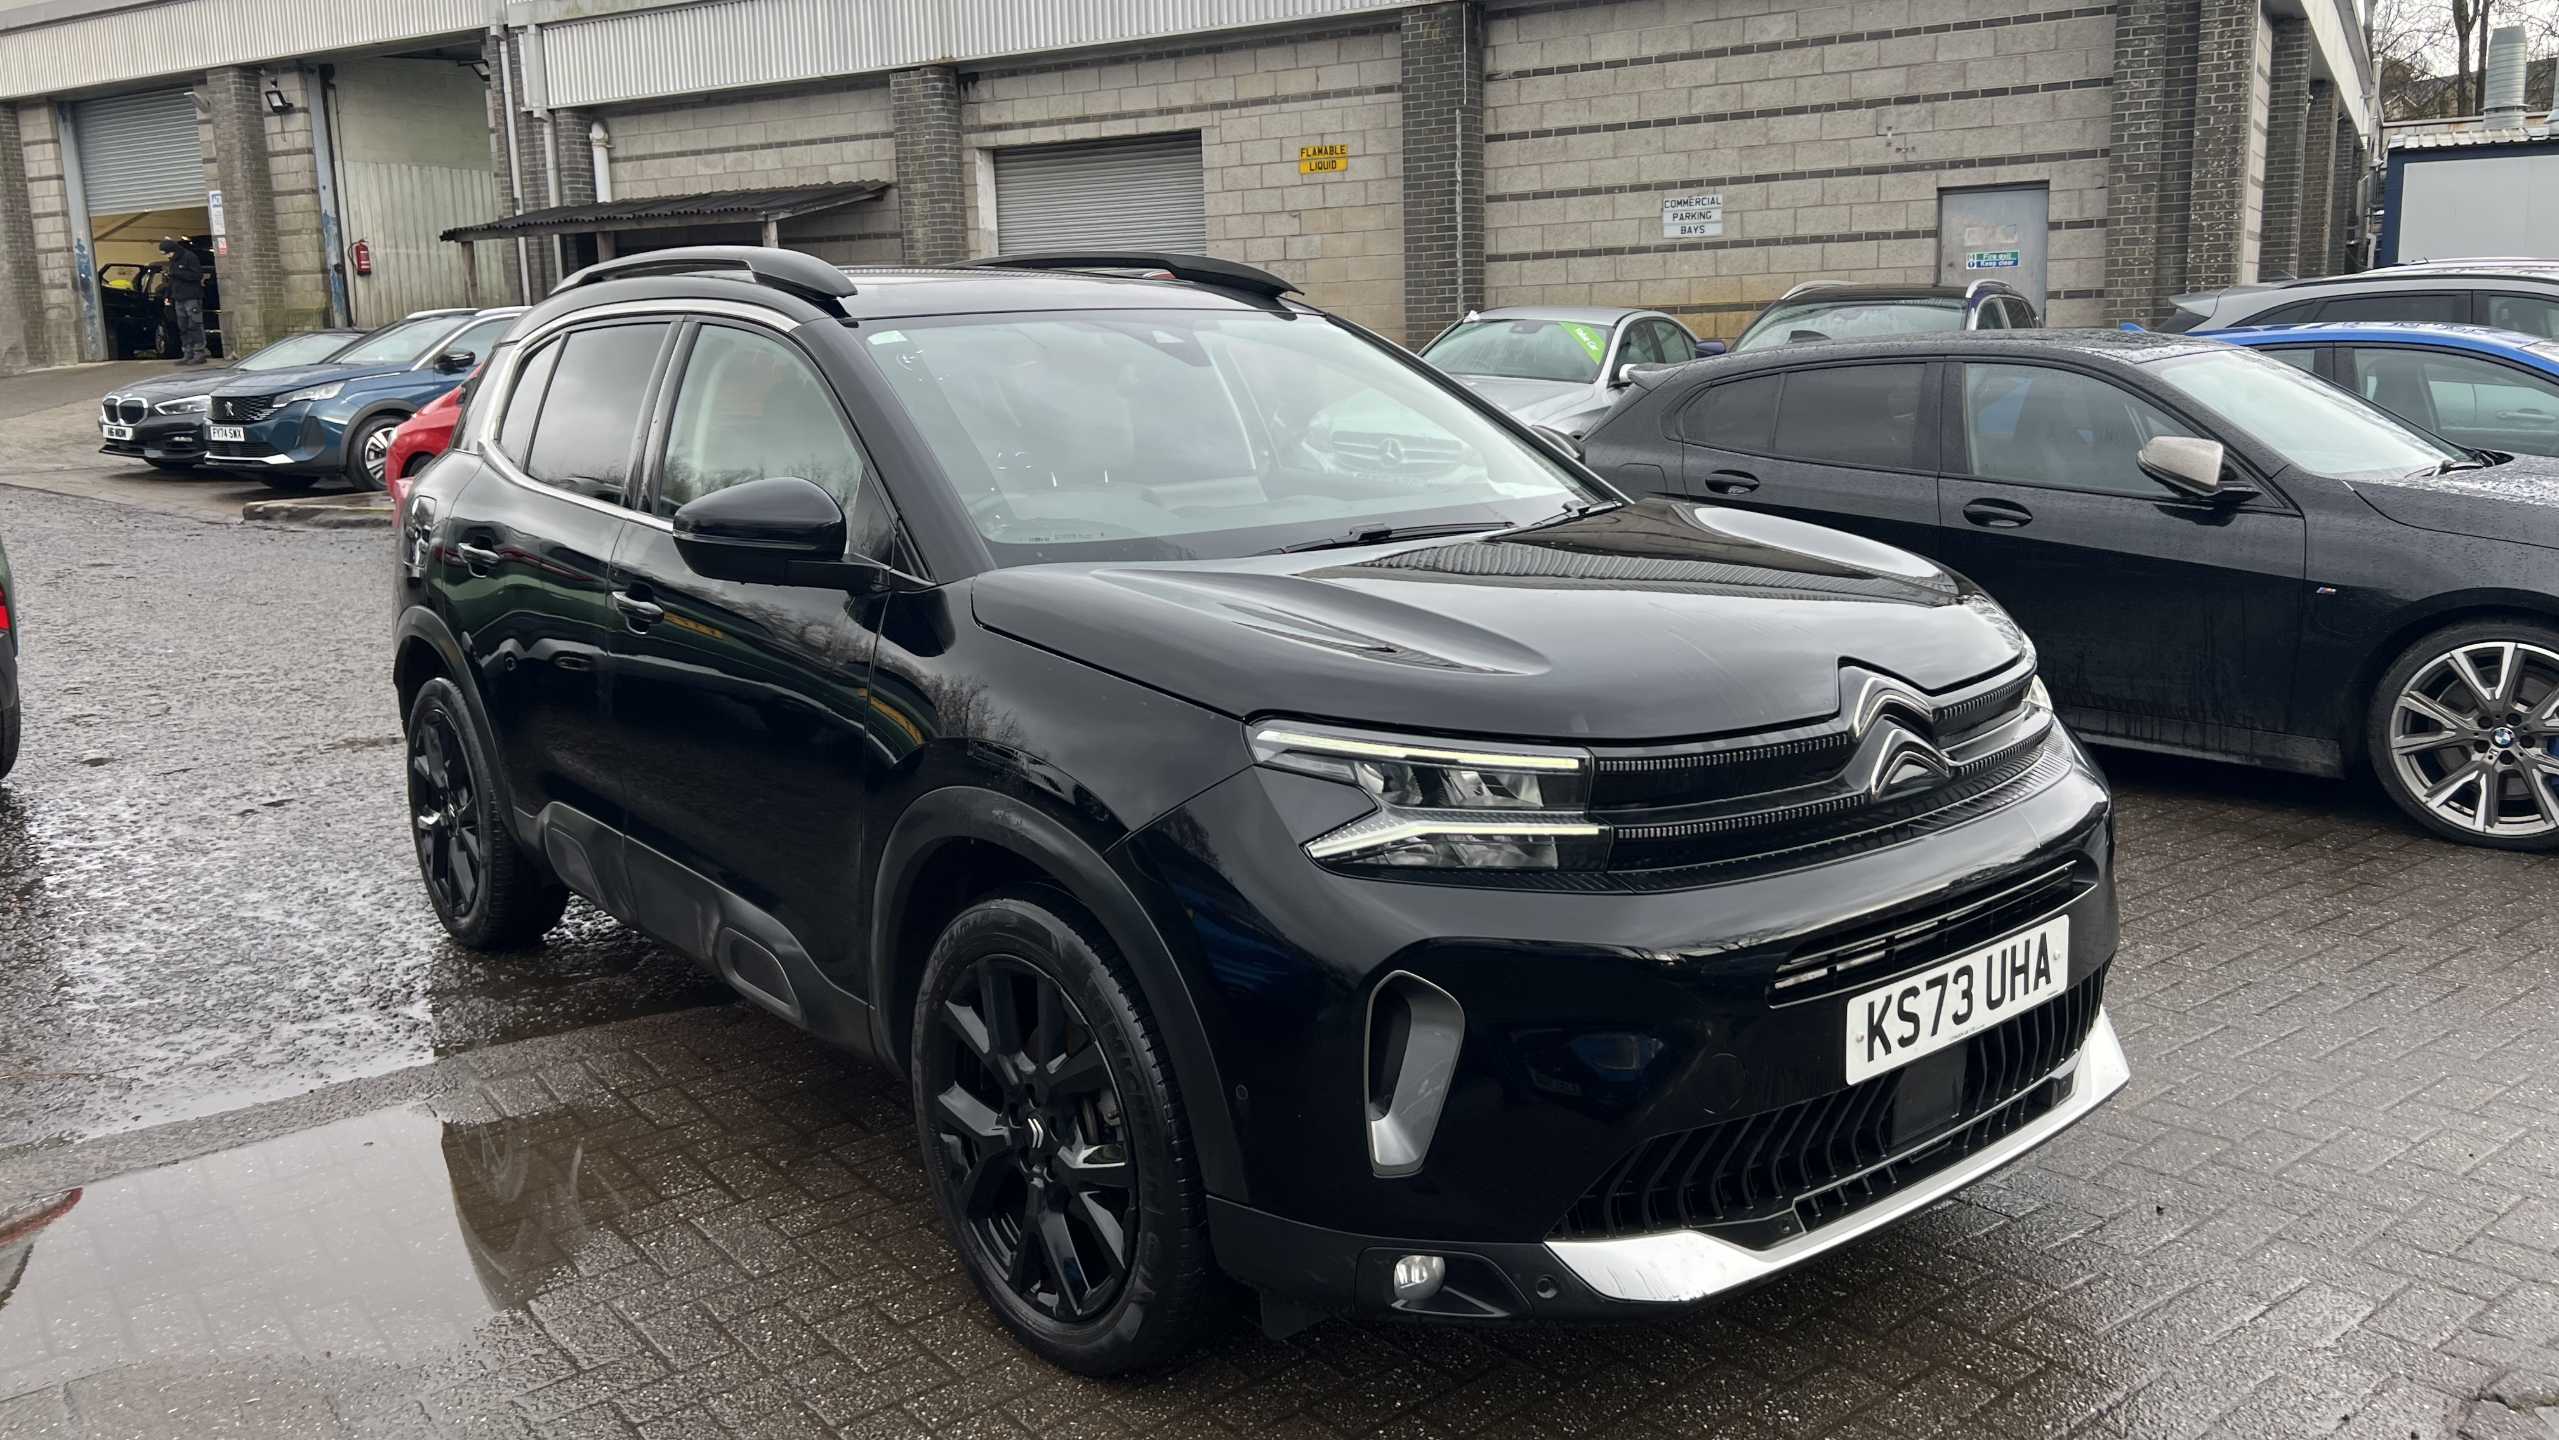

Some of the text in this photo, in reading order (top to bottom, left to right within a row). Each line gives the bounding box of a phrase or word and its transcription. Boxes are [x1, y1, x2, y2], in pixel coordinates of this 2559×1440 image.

[1300, 144, 1346, 158] FLAMABLE
[1309, 160, 1337, 171] LIQUID
[1664, 196, 1721, 209] COMMERCIAL
[1672, 211, 1712, 221] PARKING
[1680, 225, 1705, 235] BAYS
[1867, 931, 2051, 1063] KS73 UHA
